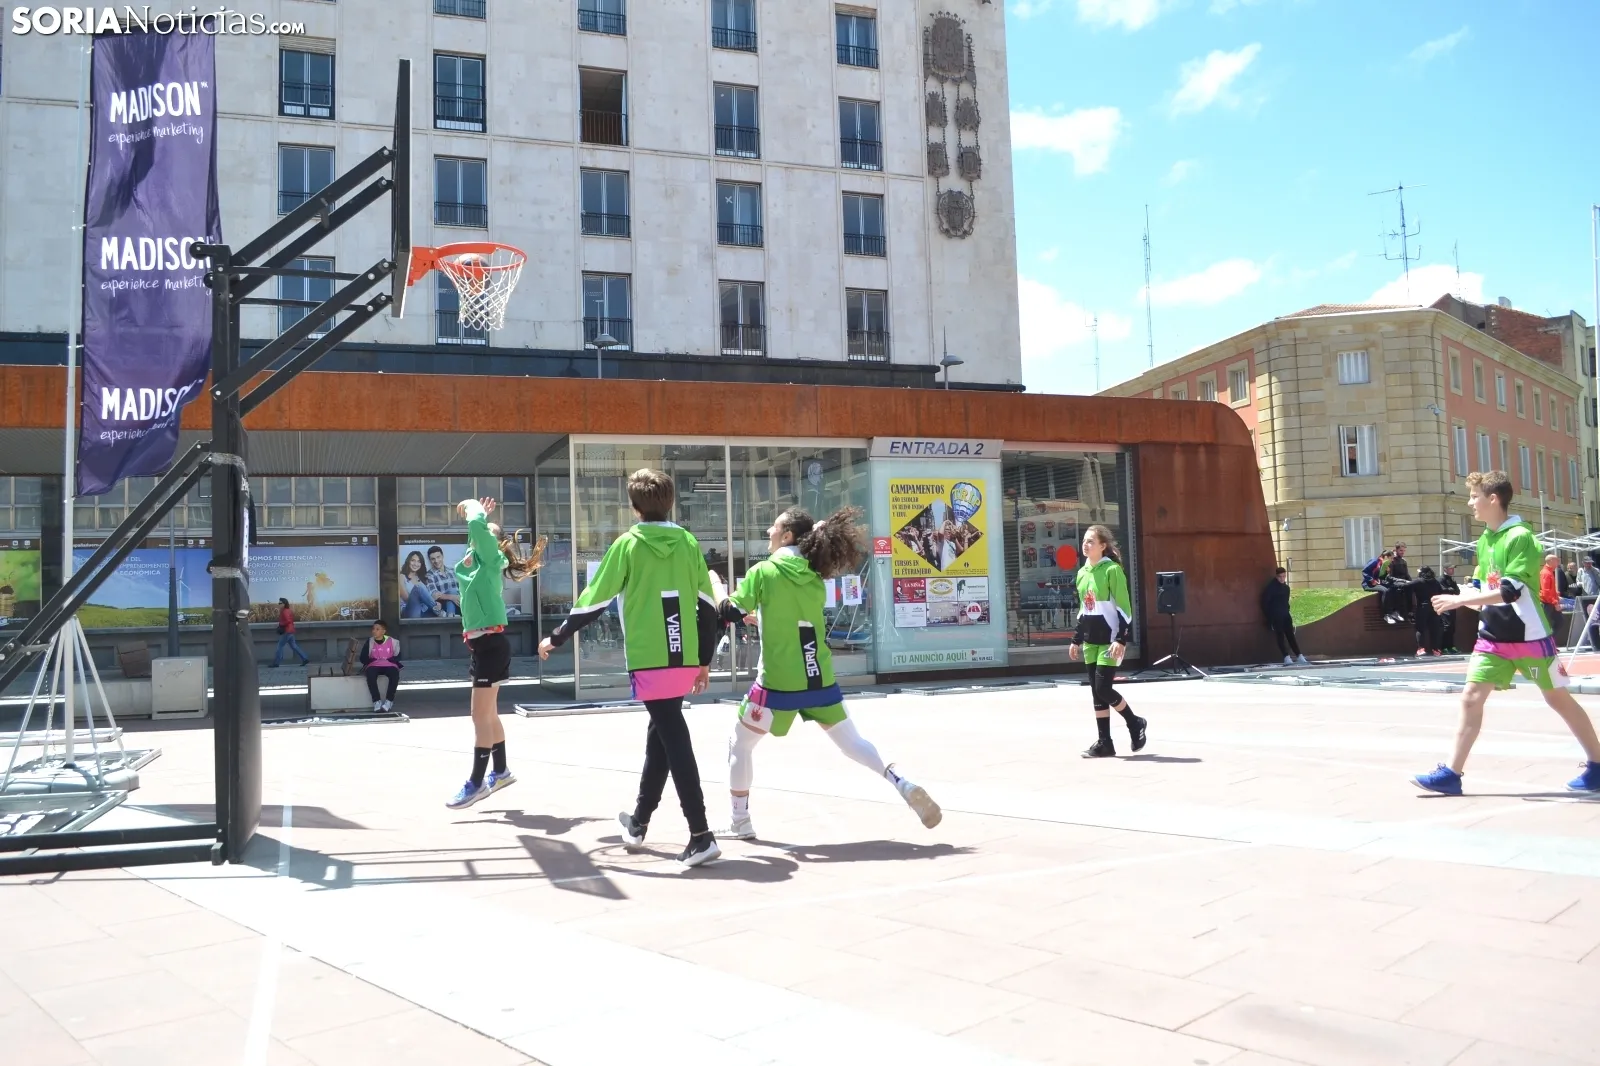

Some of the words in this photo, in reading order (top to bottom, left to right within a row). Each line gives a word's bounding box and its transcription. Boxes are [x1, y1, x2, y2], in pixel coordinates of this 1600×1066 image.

[110, 81, 201, 125] MADISON
[108, 129, 152, 151] experience
[153, 123, 204, 144] marketing
[101, 278, 159, 297] experience
[165, 275, 212, 296] marketi
[101, 380, 198, 421] MADIS
[100, 428, 150, 448] experienc
[889, 441, 970, 455] ENTRADA
[974, 443, 984, 455] 2
[891, 484, 945, 495] CAMPAMENTOS
[666, 613, 681, 653] SORIA
[803, 640, 820, 677] SORIA
[893, 655, 907, 665] ¡TU
[909, 651, 944, 663] ANUNCIO
[946, 650, 967, 662] AQUÍ!
